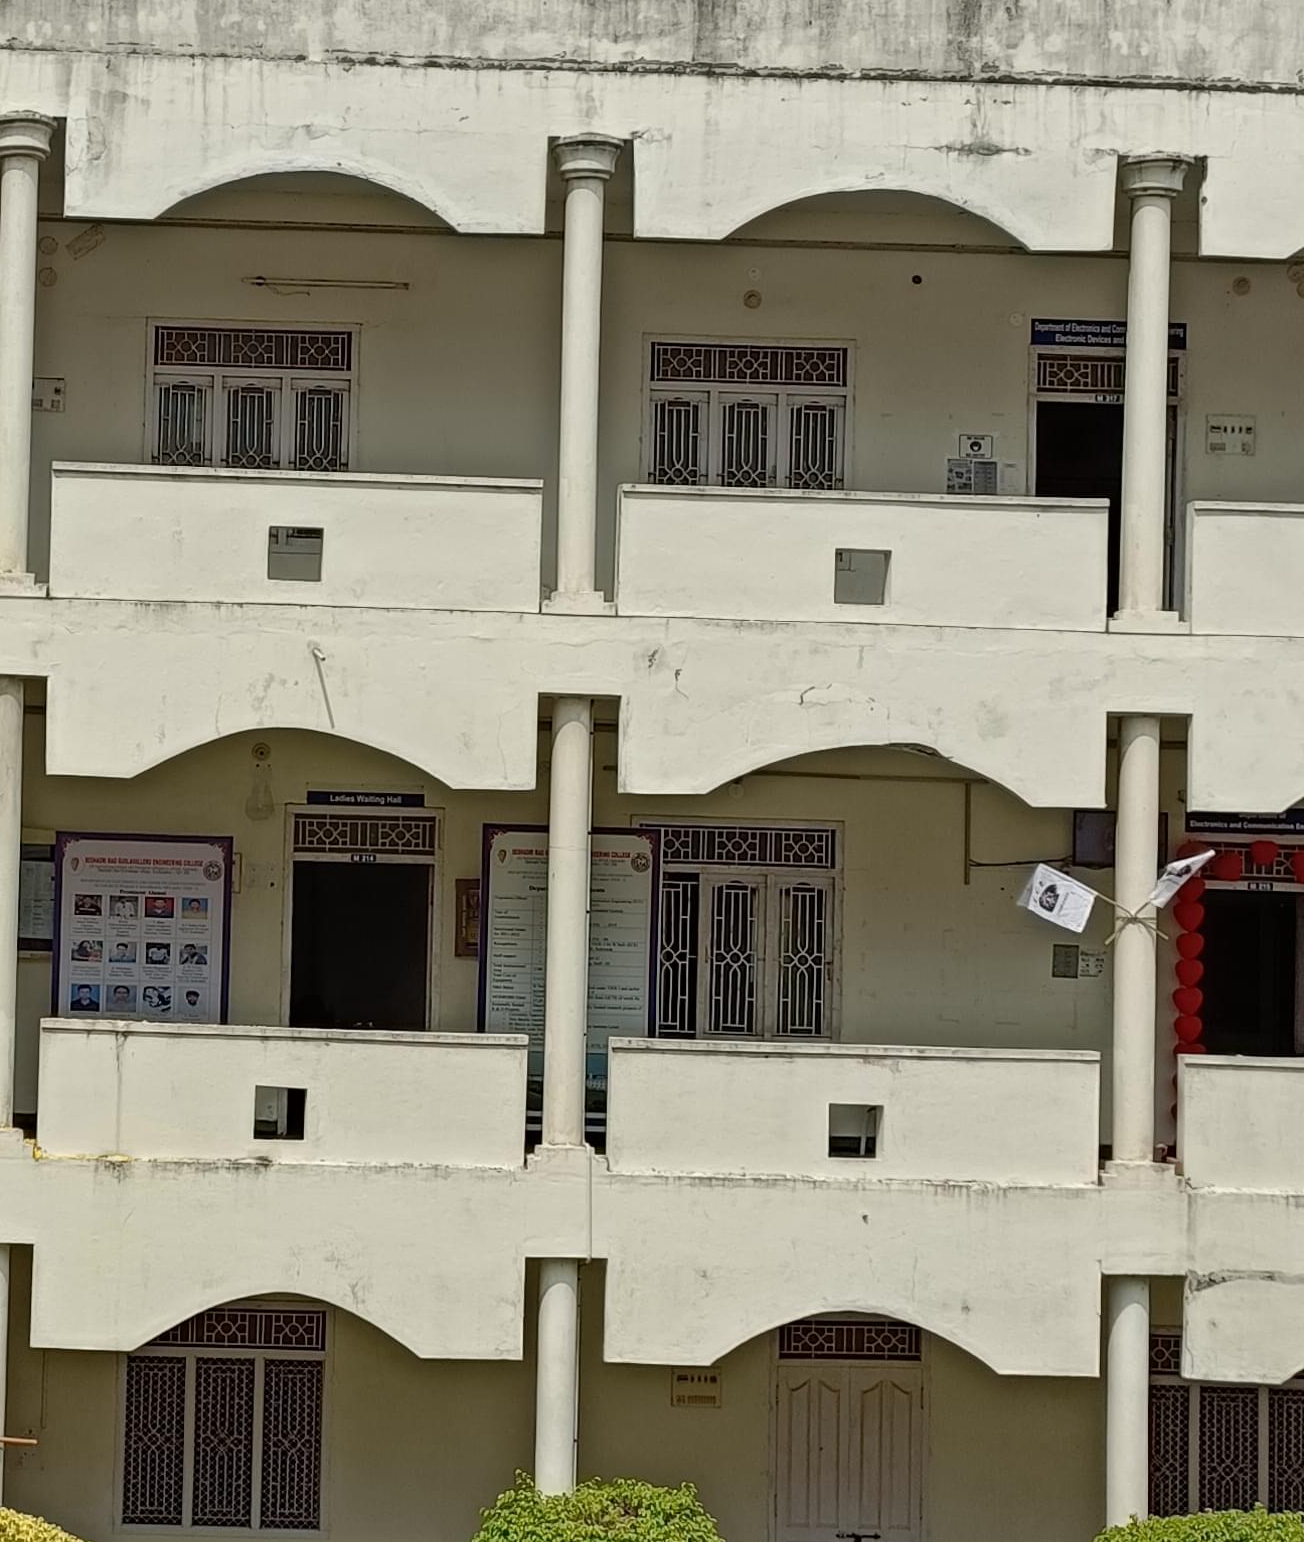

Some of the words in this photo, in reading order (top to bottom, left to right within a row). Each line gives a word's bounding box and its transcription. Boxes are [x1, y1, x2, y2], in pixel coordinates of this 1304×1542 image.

[1055, 334, 1086, 344] Electronic
[1087, 335, 1112, 344] Devices
[329, 794, 355, 803] Ladies
[356, 795, 385, 804] Waiting
[387, 795, 402, 804] Hall
[1190, 820, 1228, 828] Electronics
[1229, 821, 1242, 829] and
